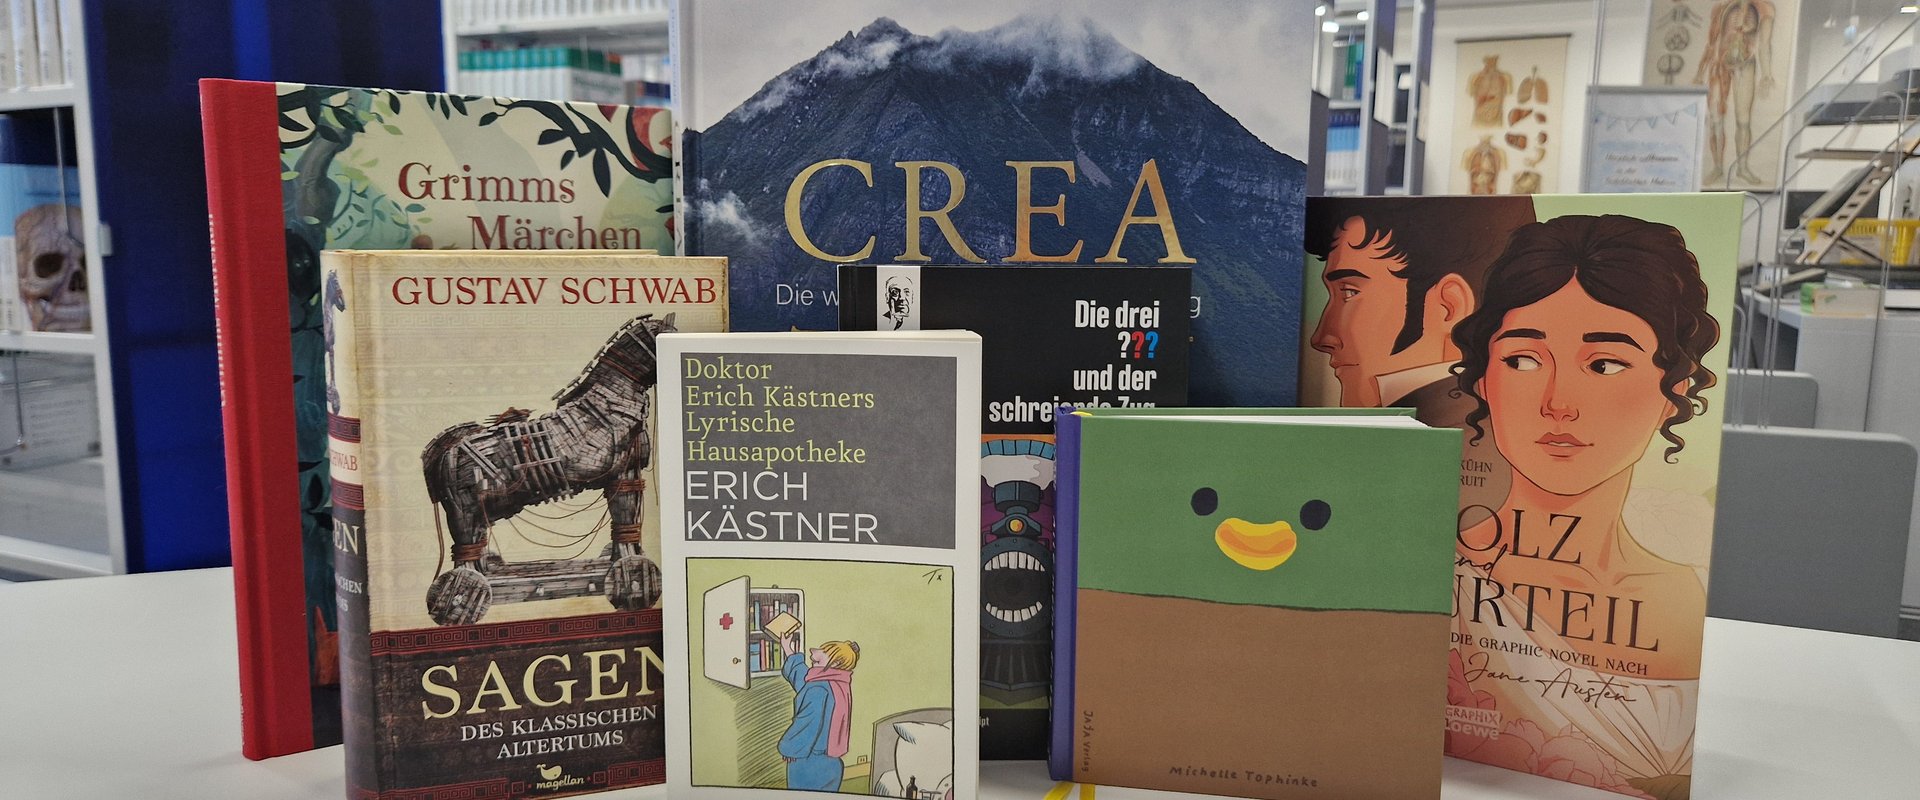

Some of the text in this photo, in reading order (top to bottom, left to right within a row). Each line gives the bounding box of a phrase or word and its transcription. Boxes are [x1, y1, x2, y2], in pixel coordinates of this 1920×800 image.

[398, 162, 575, 203] Grimms
[784, 158, 1197, 264] CREA
[467, 215, 641, 250] Märchen
[392, 277, 717, 305] GUSTAV SCHWAB
[776, 283, 814, 306] Die
[1075, 300, 1109, 328] Die
[1115, 300, 1160, 328] drei
[1117, 331, 1159, 359] ???
[685, 356, 772, 379] Doktor
[1073, 364, 1157, 391] und der
[686, 384, 875, 408] Erich Kästners
[686, 410, 795, 440] Lyrische
[687, 440, 866, 469] Hausapotheke
[686, 471, 807, 500] ERICH
[687, 505, 879, 543] KÄSTNER
[1456, 504, 1581, 565] OLZ
[1454, 543, 1508, 585] nd
[1451, 632, 1648, 676] DIE GRAPHIC NOVEL NACH
[1462, 652, 1637, 708] Jane Austen
[461, 704, 657, 742] DES KLASSISCHEN
[497, 730, 624, 760] ALTERTUMS
[536, 774, 585, 791] magellan
[1169, 766, 1318, 788] Michelle Tophinke
